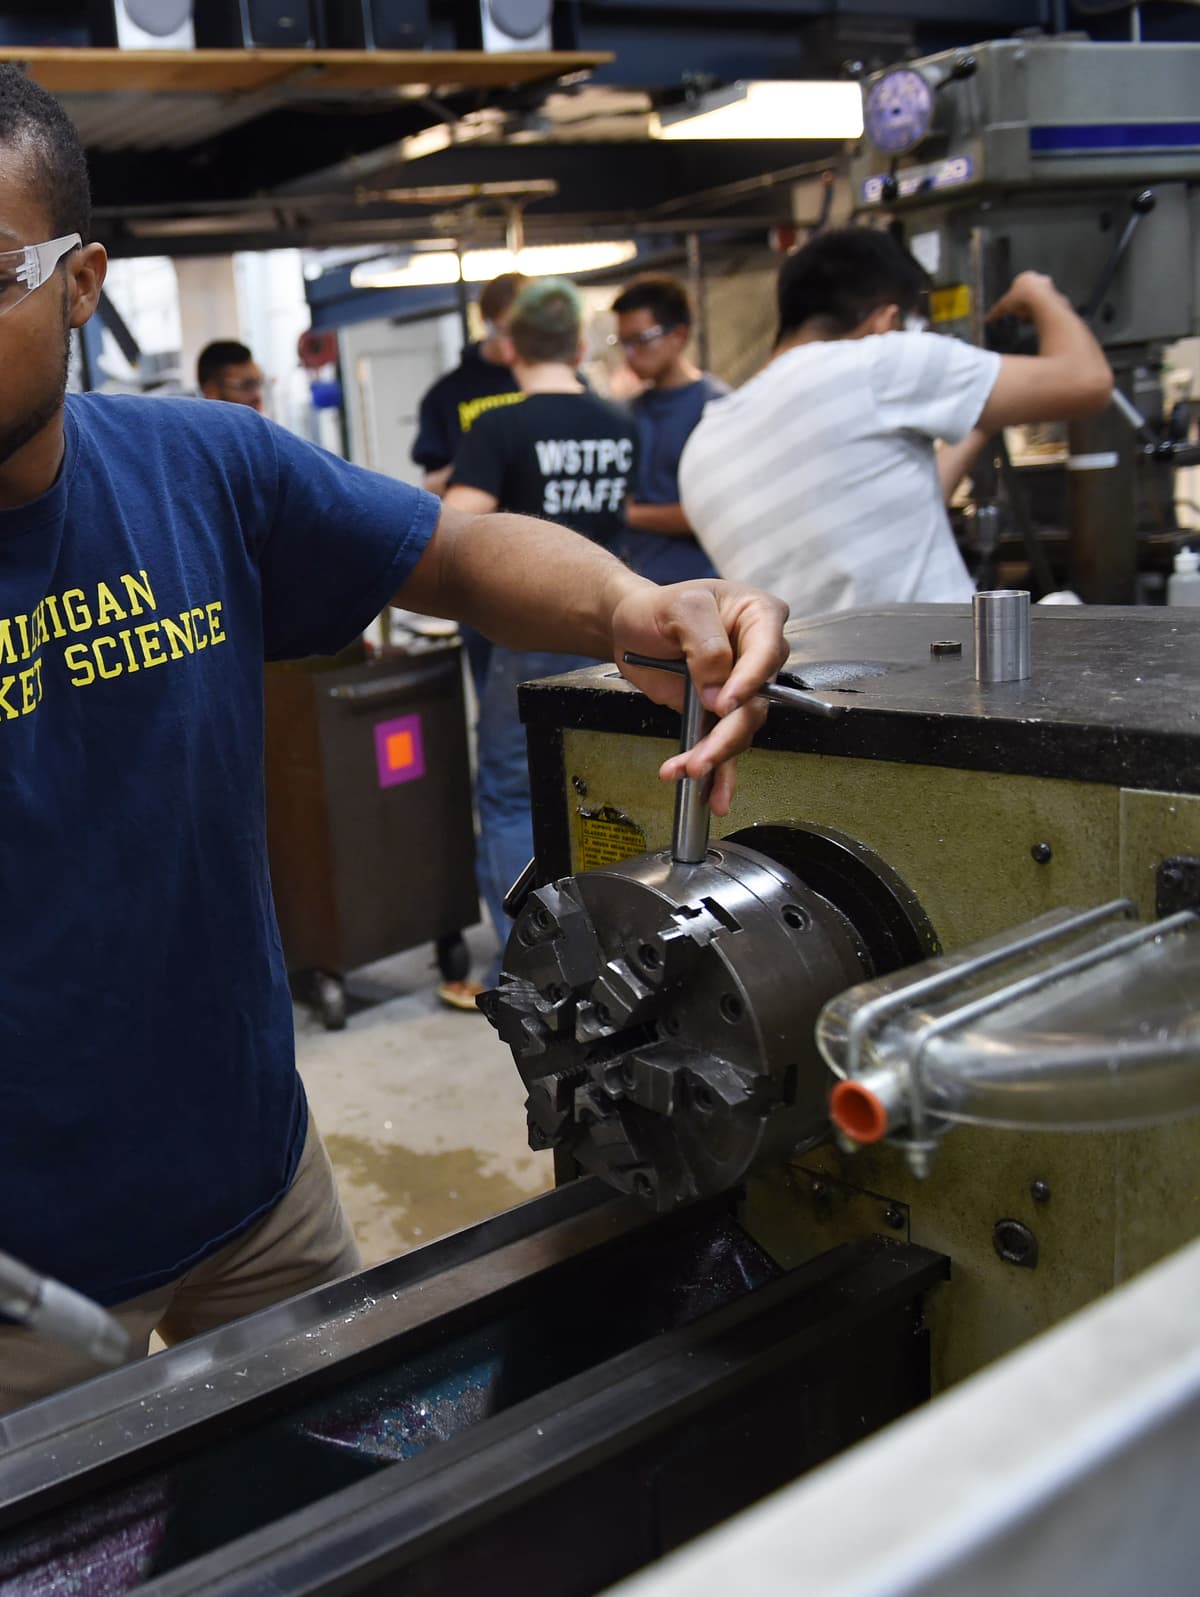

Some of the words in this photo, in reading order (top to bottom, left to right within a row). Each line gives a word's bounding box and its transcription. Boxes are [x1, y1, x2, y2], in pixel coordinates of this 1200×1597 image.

[535, 438, 633, 476] WSTPC
[543, 477, 627, 515] STAFF
[64, 601, 226, 688] SCIENCE
